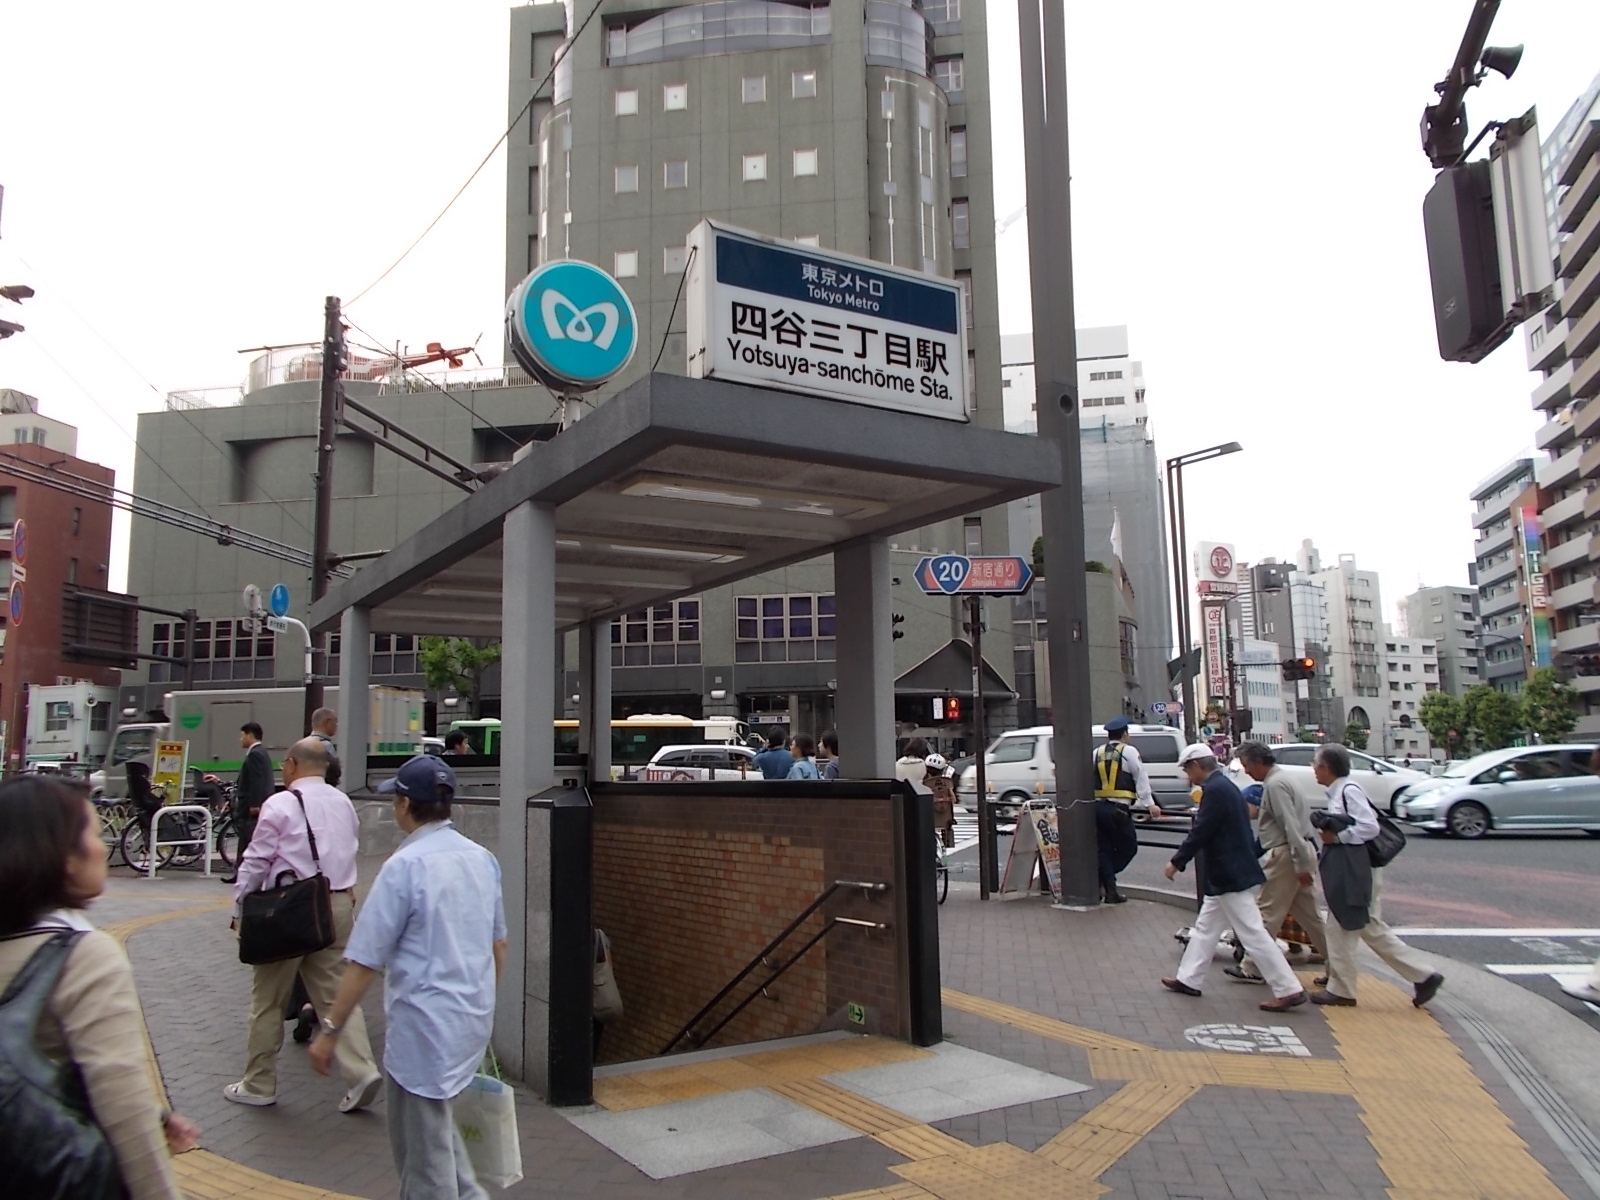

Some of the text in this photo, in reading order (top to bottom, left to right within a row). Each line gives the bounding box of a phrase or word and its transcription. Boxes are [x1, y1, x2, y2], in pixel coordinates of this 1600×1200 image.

[801, 262, 884, 298] 東京メトロ
[806, 284, 880, 312] Tokyo Metro
[731, 300, 950, 377] 四谷三丁目駅
[727, 337, 953, 401] Yotsuya-sanchōme Sta.
[939, 561, 964, 582] 20
[971, 562, 1015, 578] 新宿通り
[1528, 550, 1547, 608] TIGER
[1156, 704, 1165, 712] 20
